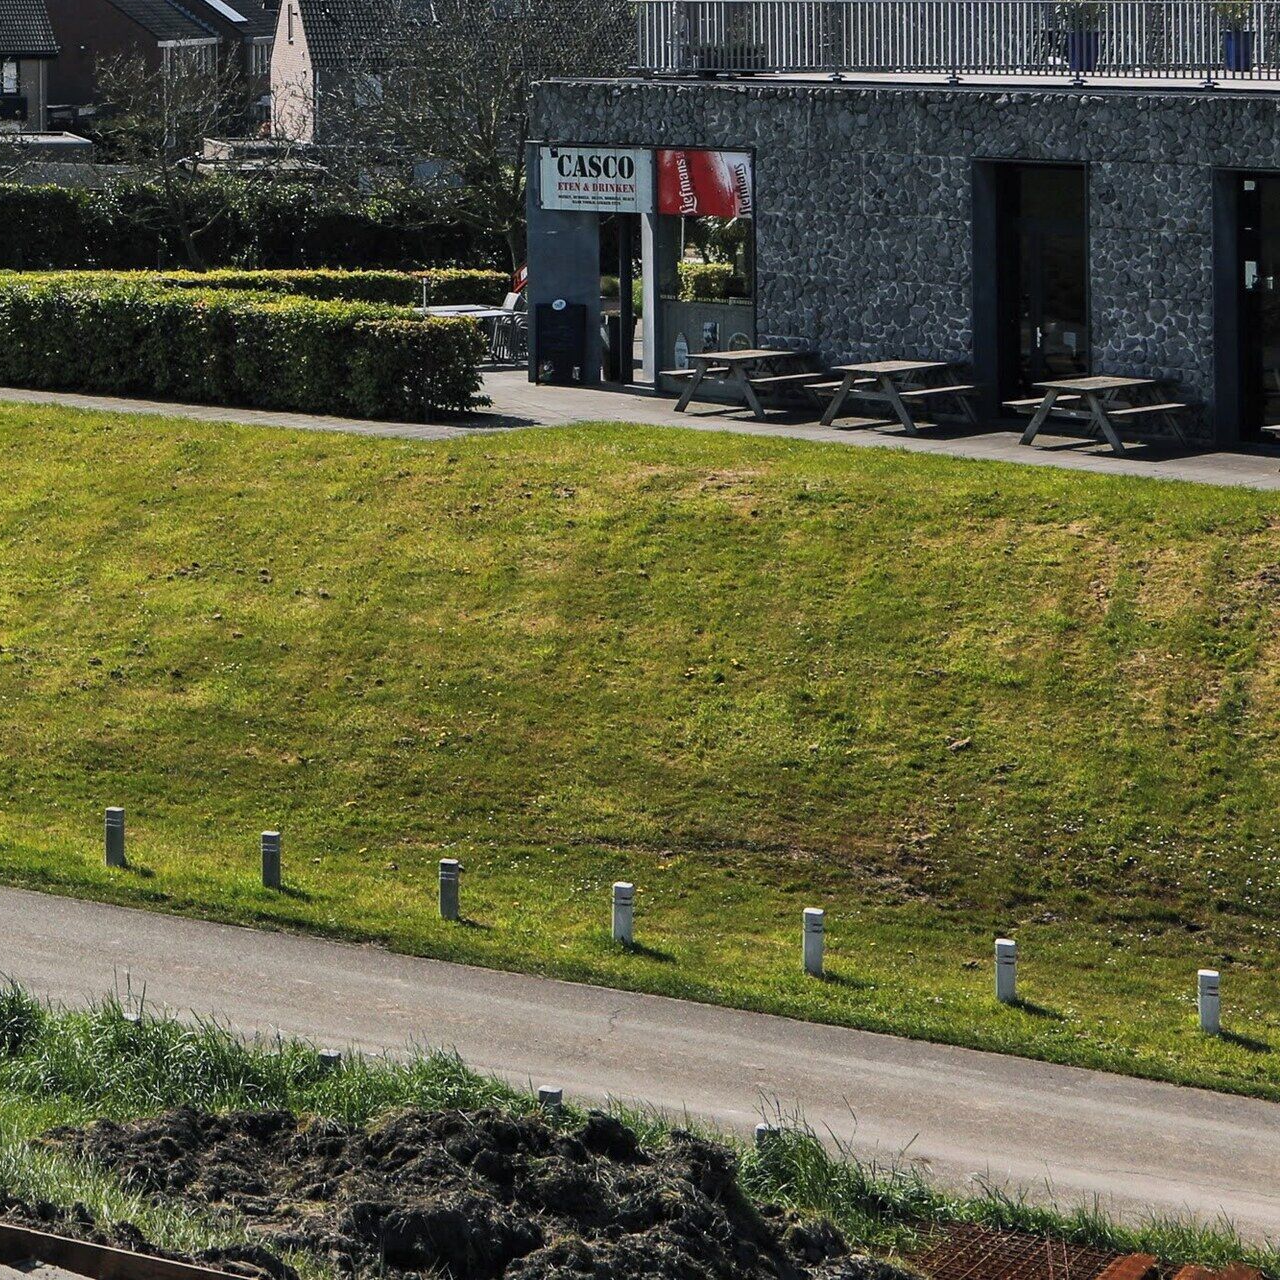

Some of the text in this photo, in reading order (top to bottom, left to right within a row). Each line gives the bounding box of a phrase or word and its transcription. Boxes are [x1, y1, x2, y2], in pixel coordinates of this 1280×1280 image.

[557, 154, 635, 179] CASCO
[557, 182, 635, 193] ETEN & DRINKEN
[676, 158, 698, 214] Liefmans
